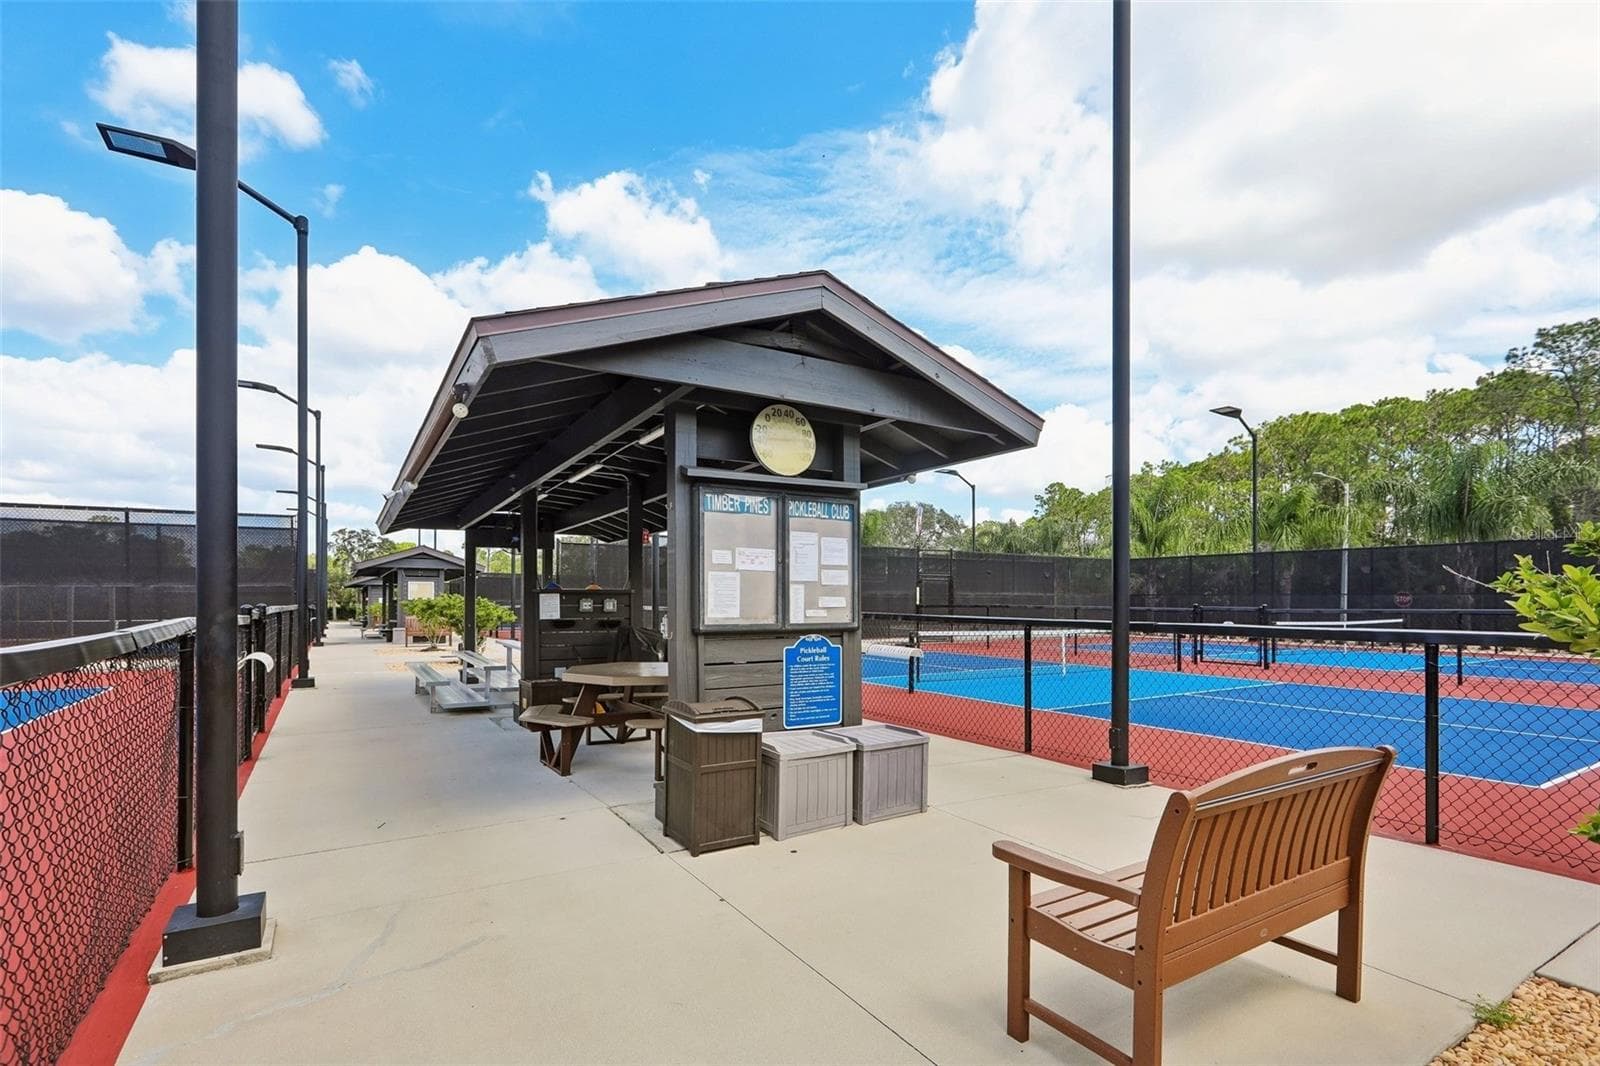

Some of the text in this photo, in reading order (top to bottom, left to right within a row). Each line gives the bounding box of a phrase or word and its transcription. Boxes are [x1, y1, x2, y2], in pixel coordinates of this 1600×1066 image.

[771, 408, 782, 417] 20
[783, 409, 794, 419] 40
[765, 413, 771, 422] 0
[795, 417, 806, 426] 60
[705, 494, 769, 514] TIMBER PINES
[788, 501, 850, 519] PICKLEBALL CLUB
[800, 646, 827, 654] Pickleball
